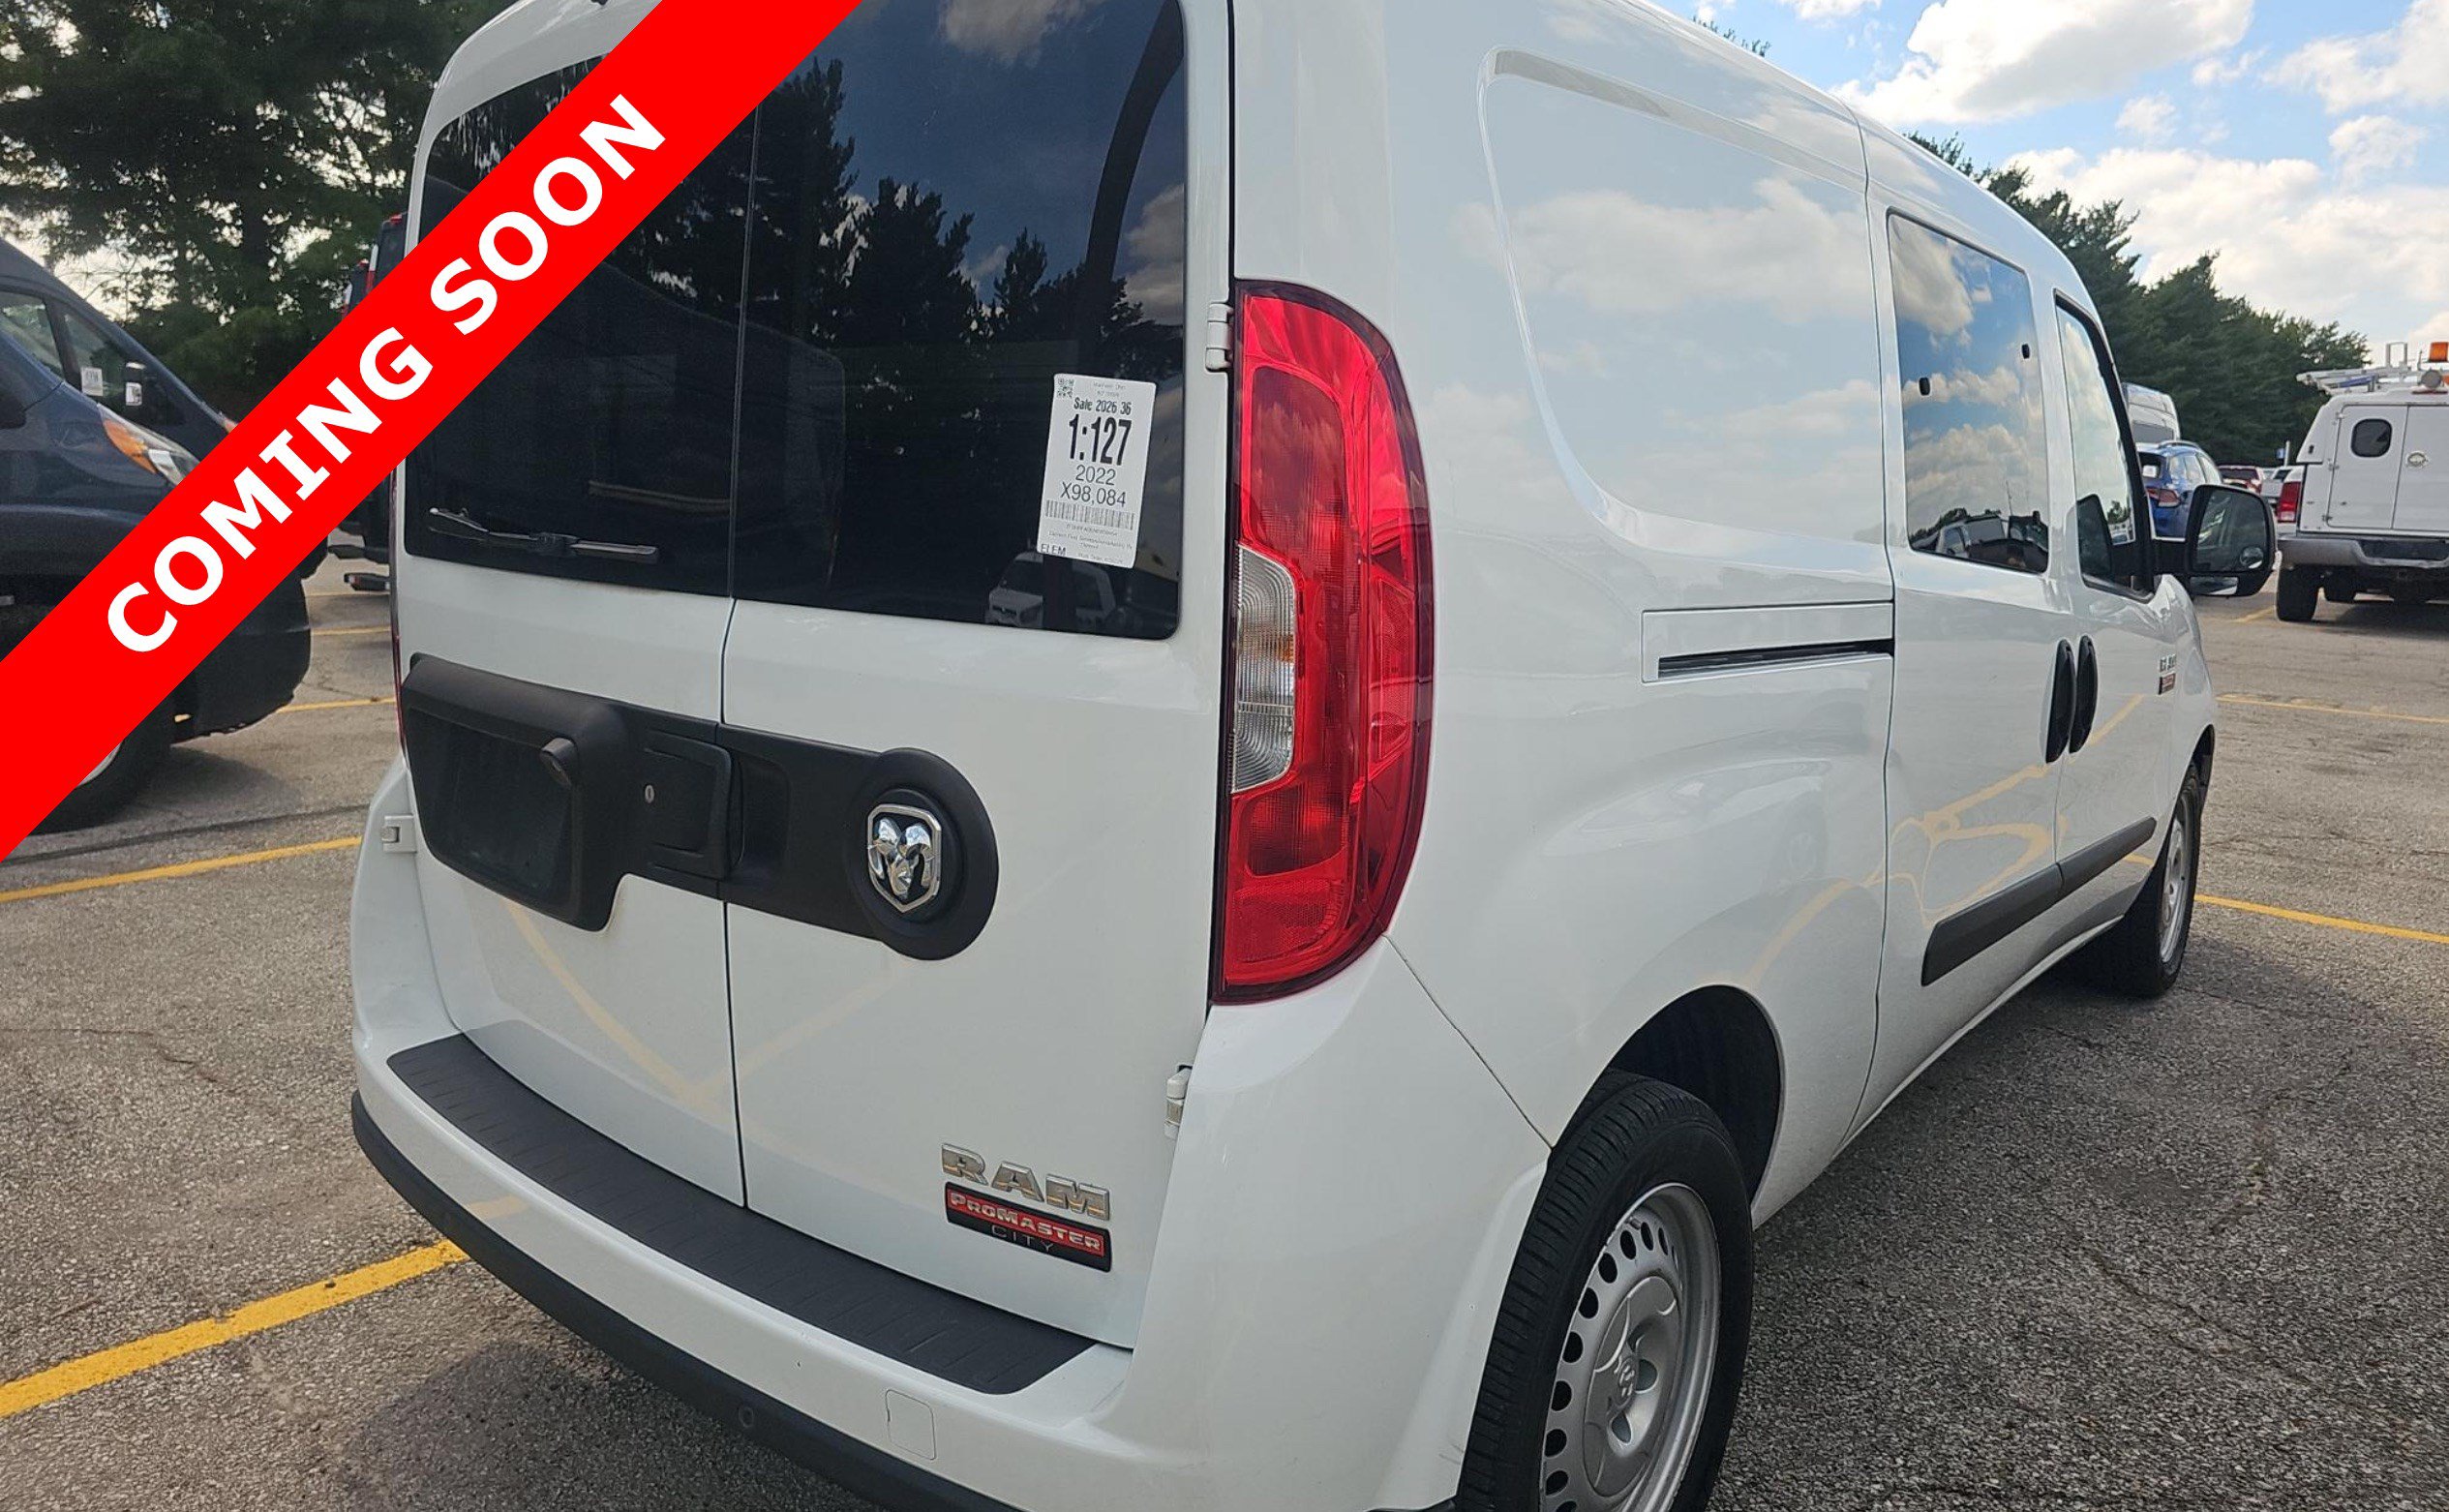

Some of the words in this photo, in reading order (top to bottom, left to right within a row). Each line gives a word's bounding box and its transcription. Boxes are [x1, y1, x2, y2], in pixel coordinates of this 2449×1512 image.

[1073, 397, 1093, 411] Sale
[1120, 401, 1133, 415] 36
[1069, 413, 1133, 466] 1:127
[1074, 465, 1117, 485] 2022
[1060, 481, 1127, 508] X98,084
[941, 1142, 1110, 1222] RAM
[991, 1224, 1054, 1253] CITY
